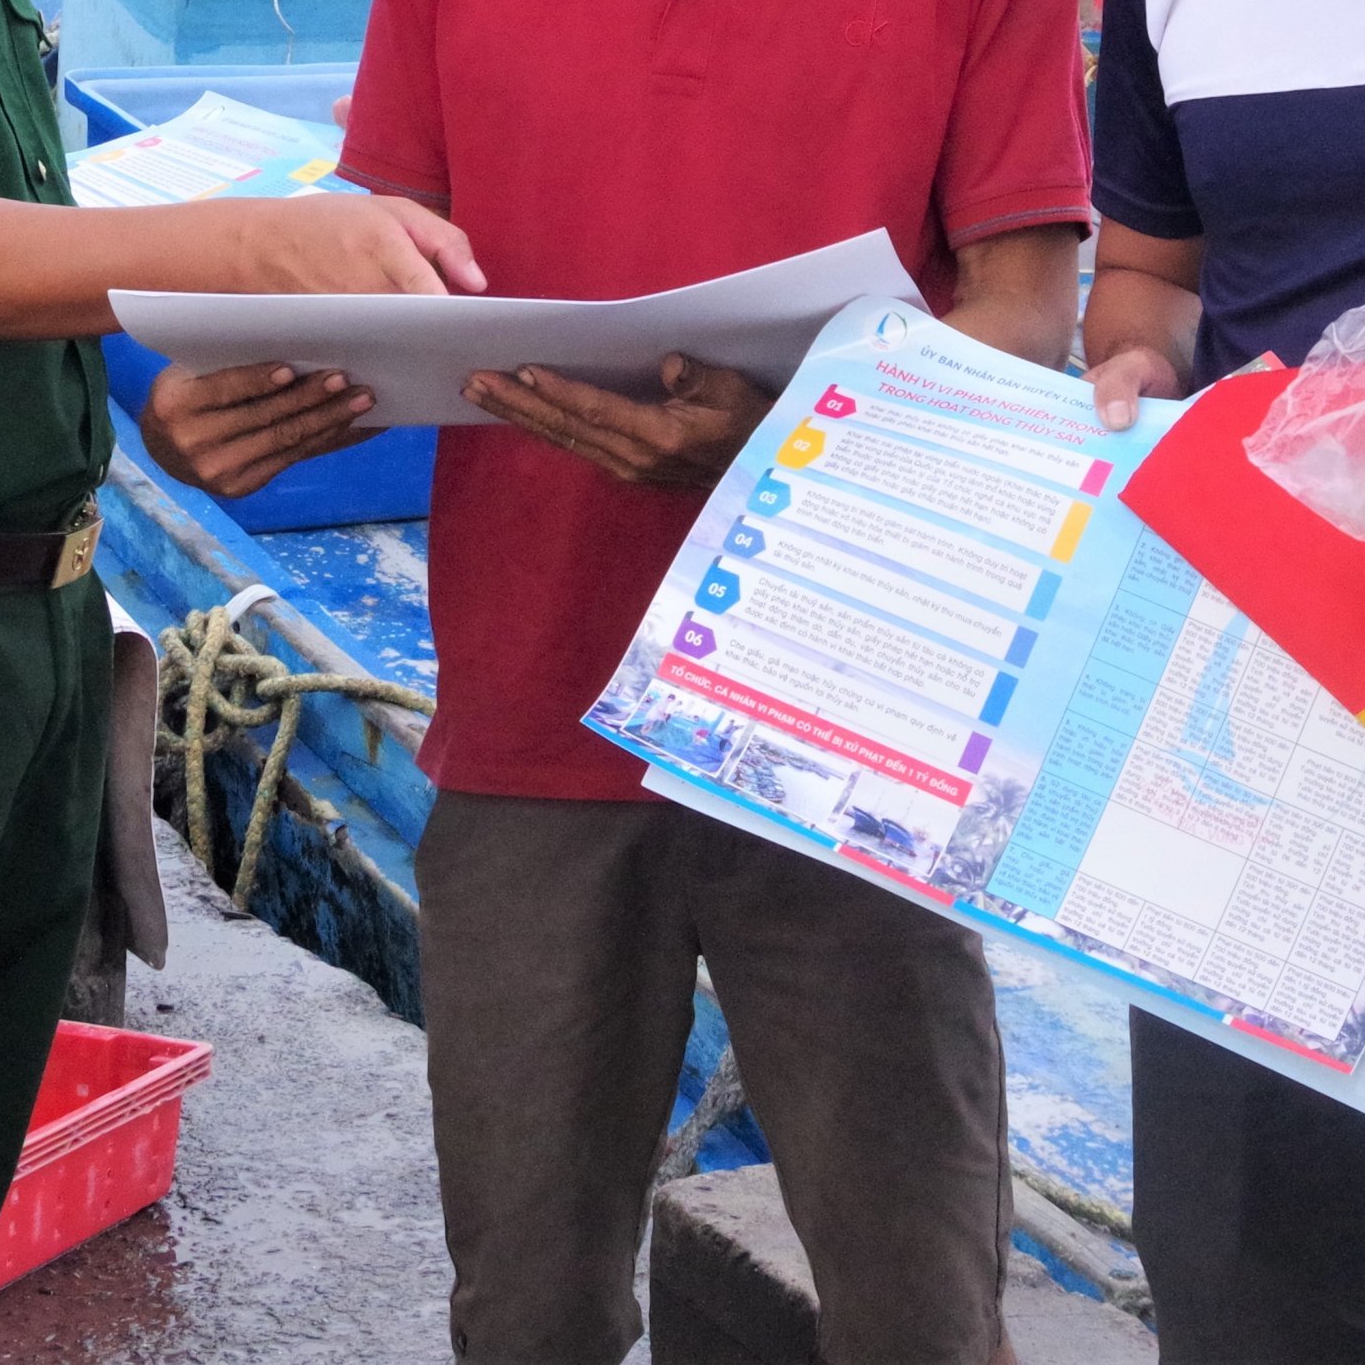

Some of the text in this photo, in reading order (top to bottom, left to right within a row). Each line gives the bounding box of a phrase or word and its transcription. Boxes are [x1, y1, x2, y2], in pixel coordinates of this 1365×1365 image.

[920, 345, 937, 360] ỦY
[938, 355, 963, 371] BAN
[963, 366, 996, 382] NHÂN
[997, 376, 1021, 390] DÂN
[1062, 396, 1095, 411] LONG
[875, 360, 921, 386] HÀNH
[922, 379, 937, 391] VI
[938, 384, 953, 396] VI
[953, 389, 997, 407] PHẠM
[998, 400, 1058, 423] NGHIÊM
[878, 382, 927, 404] TRONG
[827, 399, 843, 411] 01
[793, 439, 811, 452] 02
[759, 491, 777, 505] 03
[735, 533, 753, 548] 04
[708, 583, 727, 598] 05
[684, 630, 703, 647] 06
[714, 684, 728, 696] CÁ
[728, 691, 756, 708] NHÂN
[757, 703, 767, 713] VI
[767, 707, 795, 724] PHẠM
[796, 720, 811, 732] CÓ
[831, 735, 843, 747] BỊ
[858, 747, 884, 763] PHẠT
[908, 768, 913, 776] 1
[915, 771, 928, 782] TỶ
